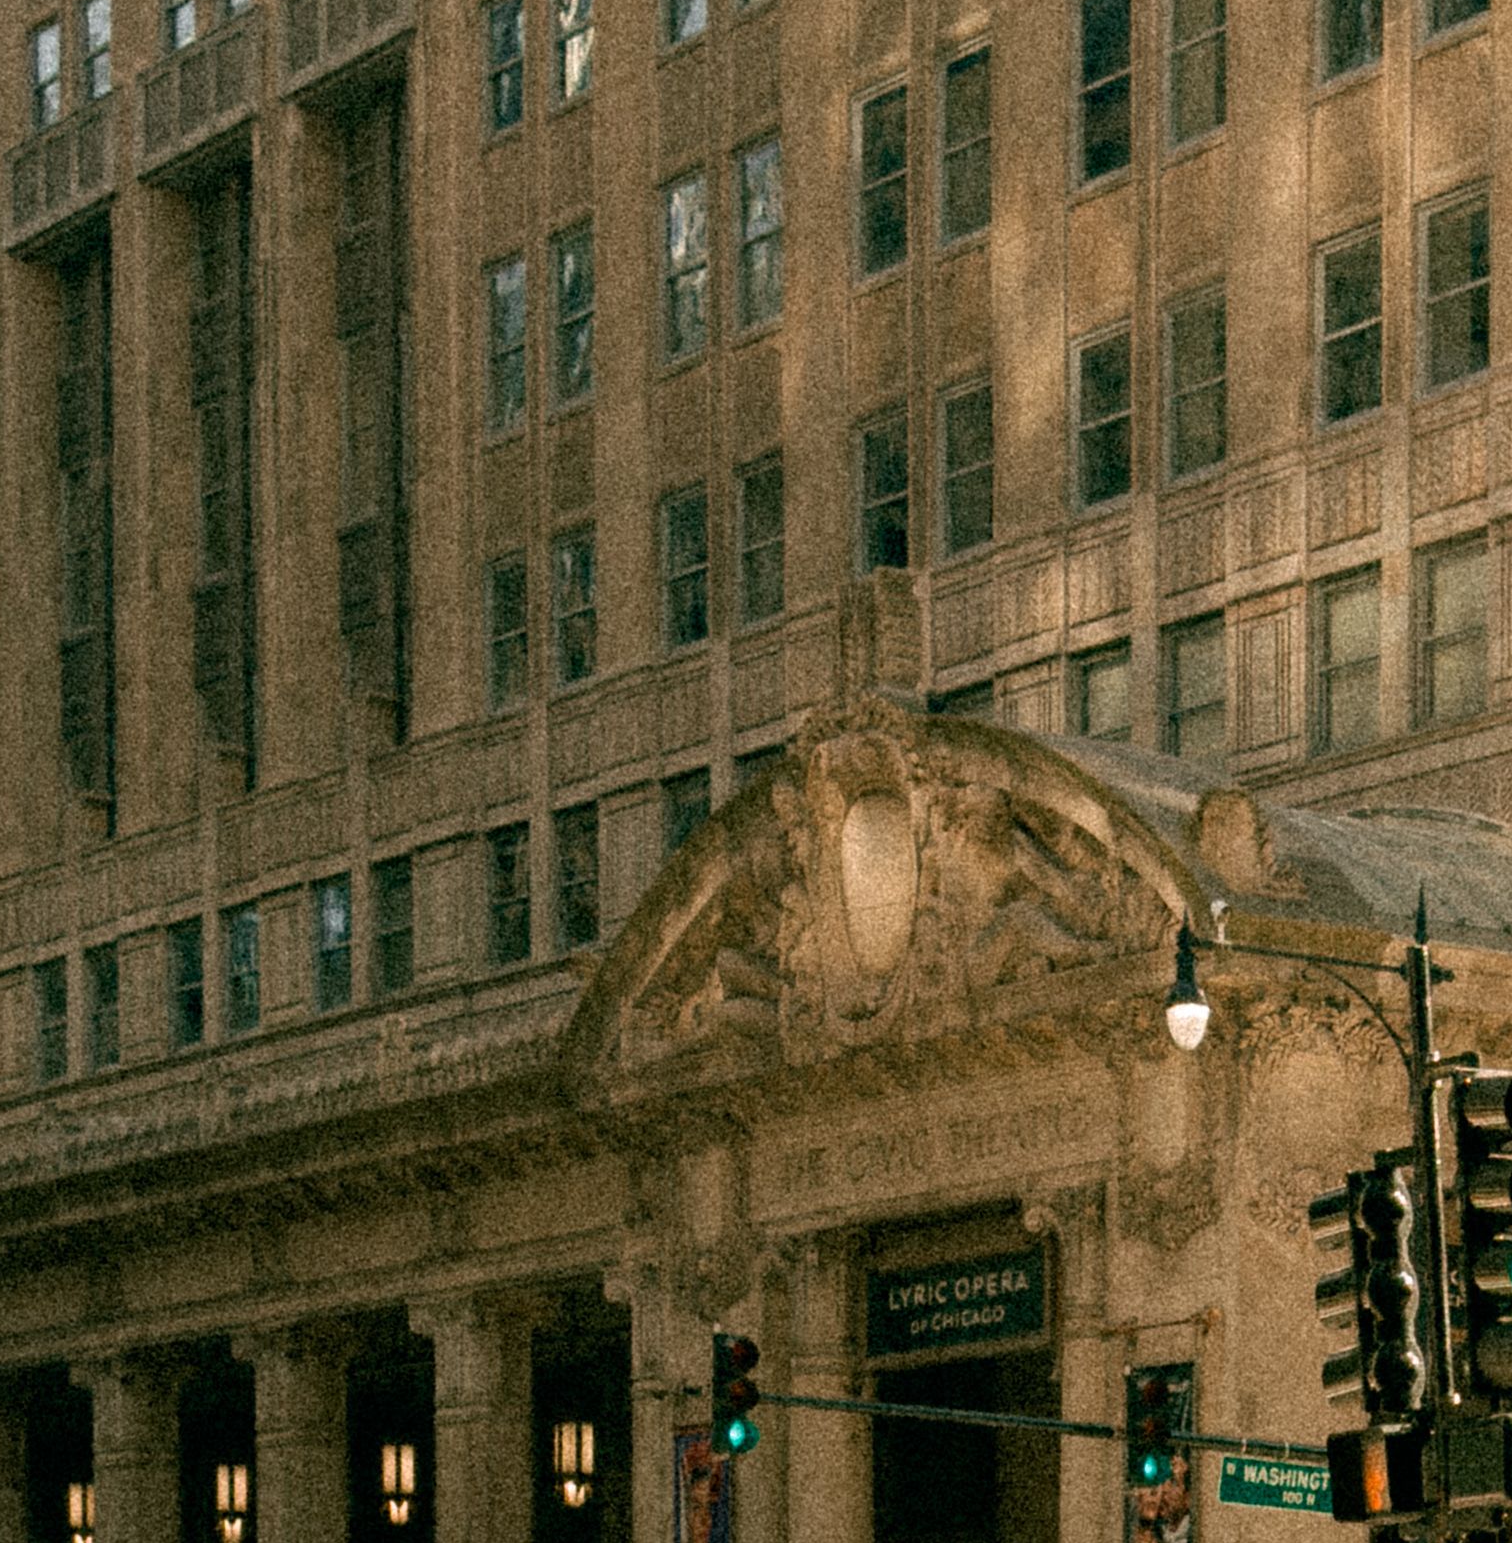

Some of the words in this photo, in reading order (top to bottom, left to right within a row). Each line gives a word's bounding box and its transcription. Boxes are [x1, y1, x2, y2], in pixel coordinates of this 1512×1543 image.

[889, 1280, 948, 1311] LYRIC
[955, 1269, 1030, 1301] OPERA
[931, 1305, 1006, 1332] CHICAGO
[1243, 1465, 1331, 1491] WASHINGT
[1282, 1490, 1303, 1505] 100
